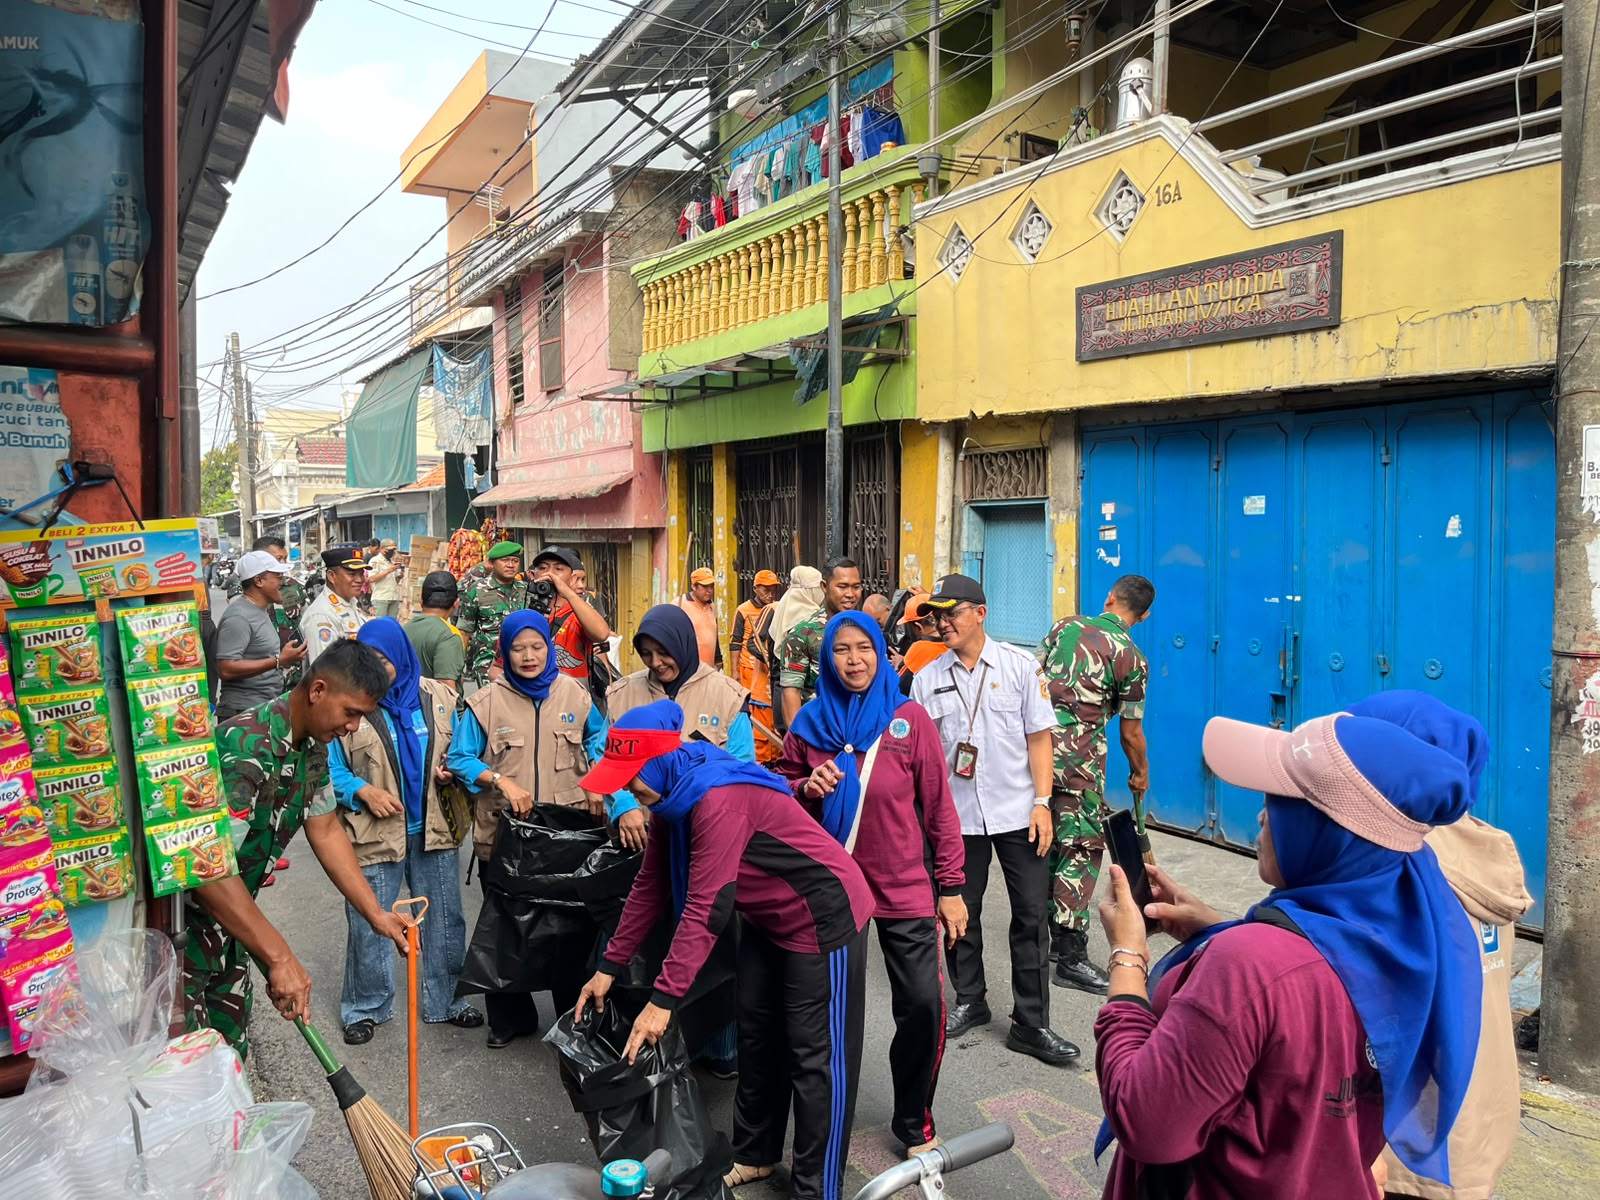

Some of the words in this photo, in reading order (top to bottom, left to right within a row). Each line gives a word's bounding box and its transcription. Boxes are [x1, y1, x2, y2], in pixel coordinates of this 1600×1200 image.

[1154, 180, 1183, 207] 16A
[1203, 268, 1287, 302] TUDDA
[16, 403, 62, 413] BUBUK
[8, 431, 67, 449] Bunuh
[49, 529, 72, 537] BELI
[77, 526, 86, 536] 2
[89, 525, 125, 534] EXTRA
[129, 523, 136, 531] 1
[7, 553, 45, 566] COKELAT
[74, 539, 142, 563] INNILO
[18, 588, 42, 597] INNILO
[145, 683, 196, 706] INNILO
[37, 700, 92, 721] INNILO
[154, 755, 206, 778] INNILO
[45, 774, 101, 796] INNILO
[163, 824, 214, 850] INNILO
[56, 845, 109, 869] INNILO
[6, 881, 44, 903] Protex
